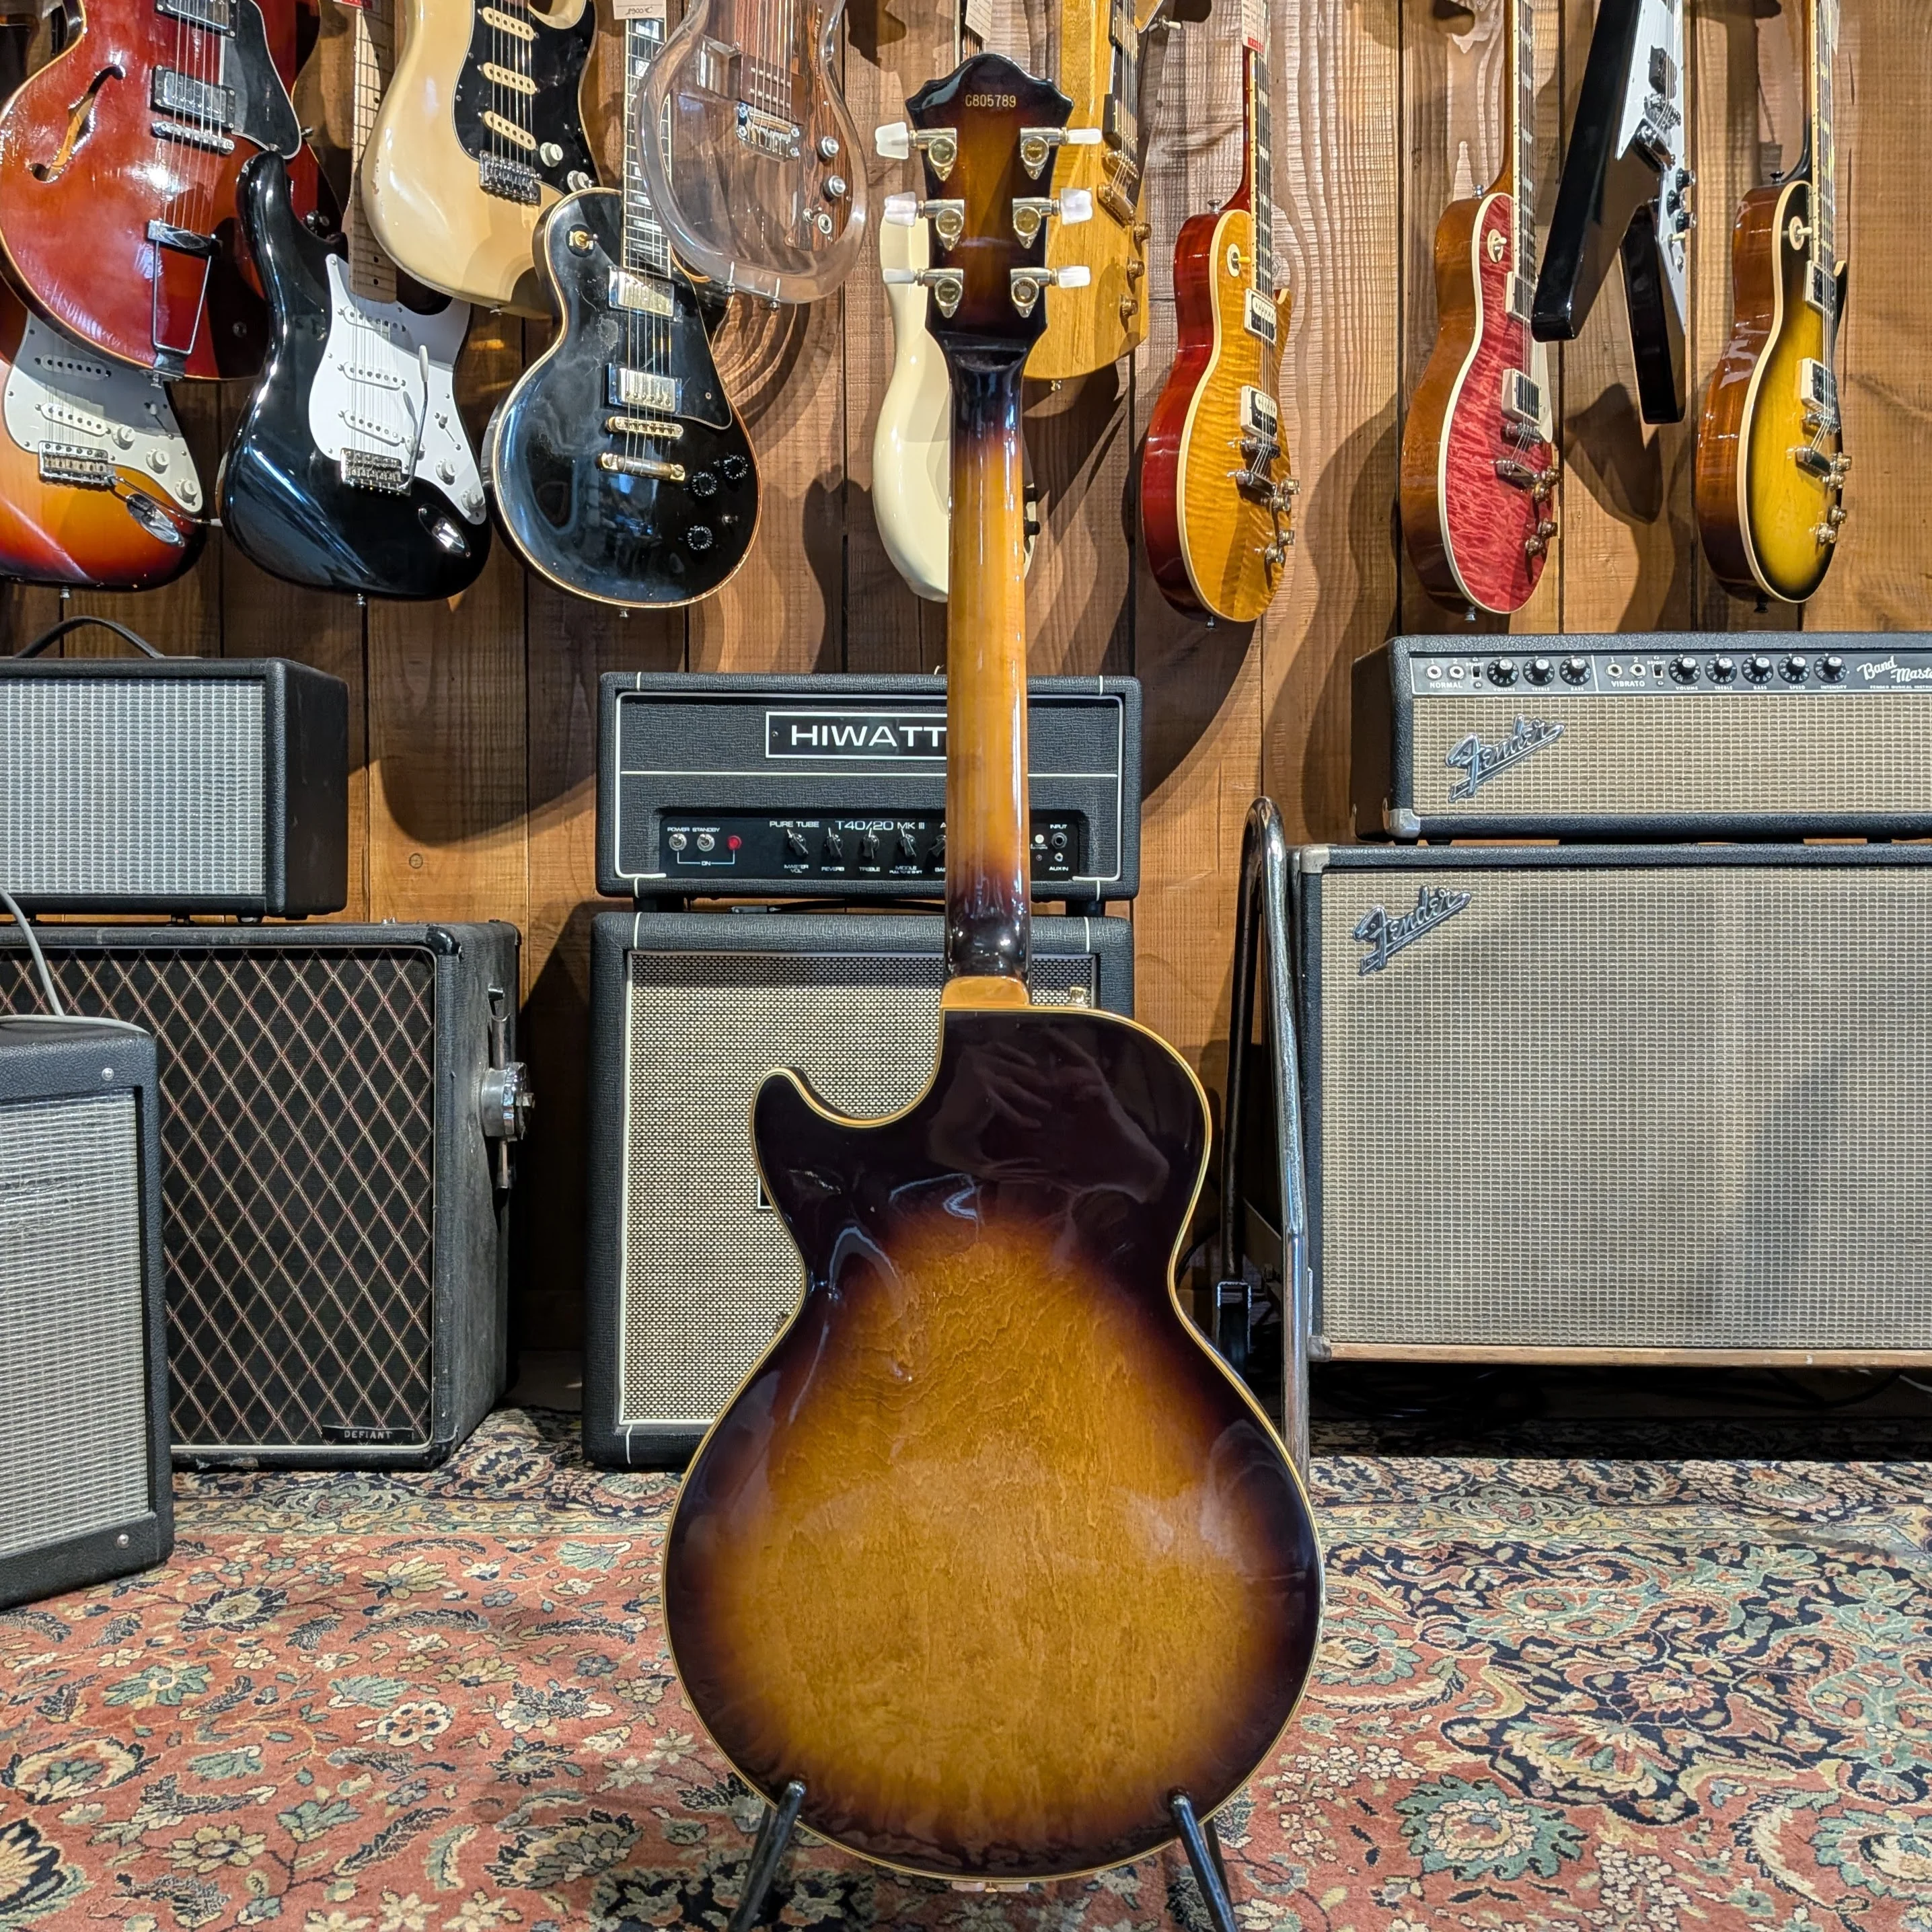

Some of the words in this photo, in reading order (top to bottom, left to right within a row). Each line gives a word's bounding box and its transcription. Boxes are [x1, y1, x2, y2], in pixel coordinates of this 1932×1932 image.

[1857, 655, 1897, 680] Band
[791, 724, 947, 747] HIWATT
[1445, 714, 1566, 803] Fender
[835, 820, 894, 831] T40/20
[1353, 884, 1473, 975] Fender
[344, 1430, 393, 1439] DEFIANT
